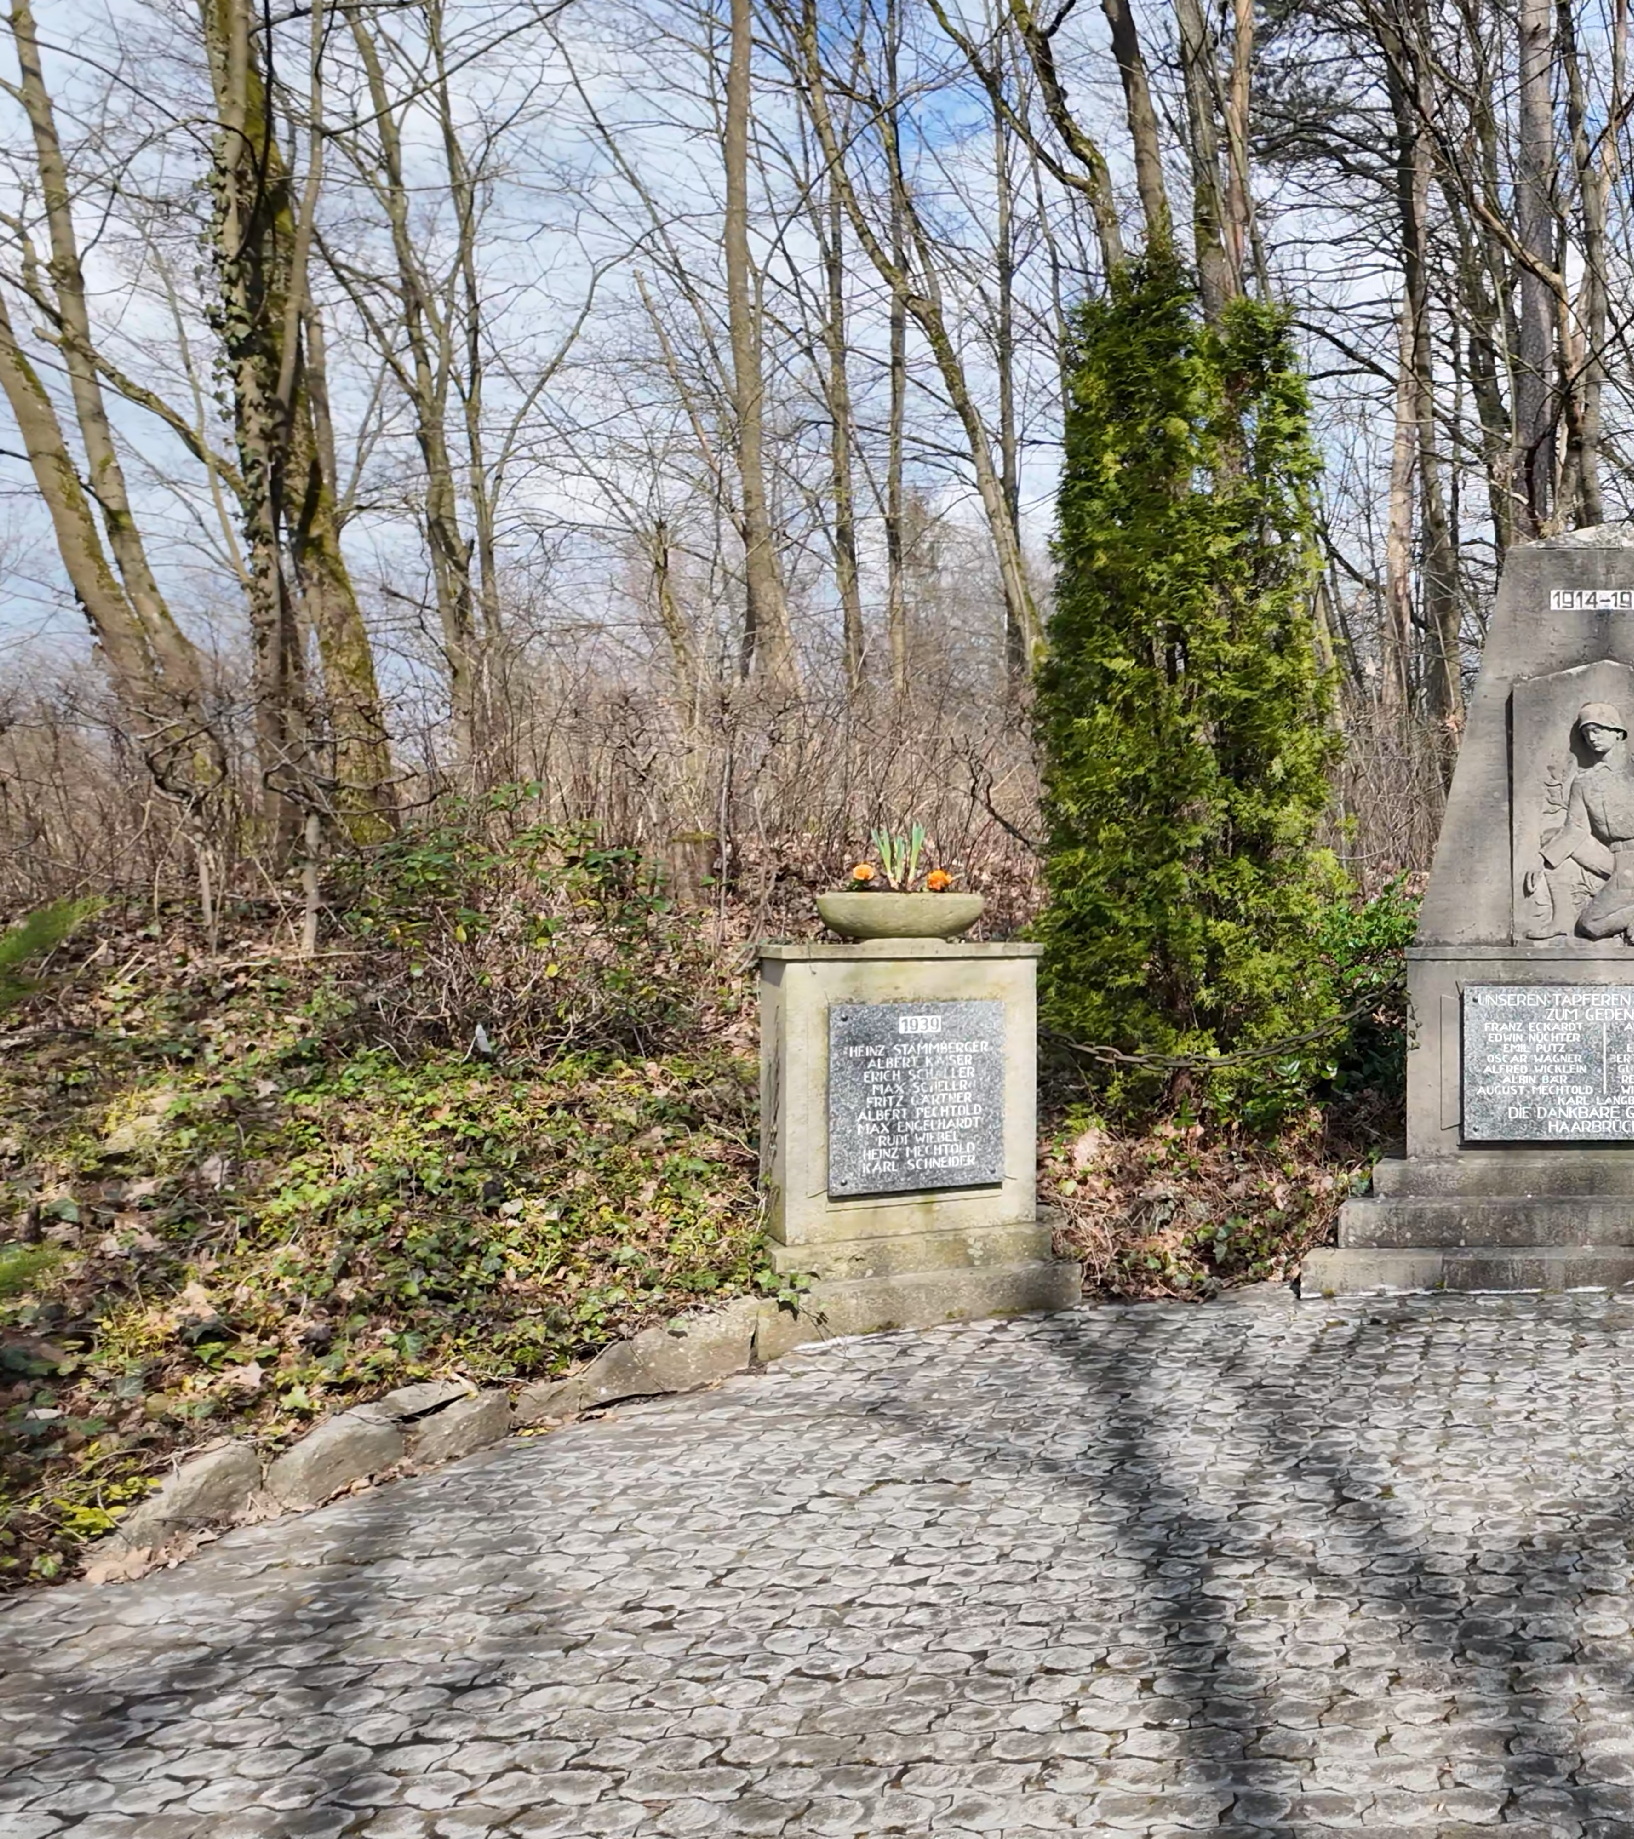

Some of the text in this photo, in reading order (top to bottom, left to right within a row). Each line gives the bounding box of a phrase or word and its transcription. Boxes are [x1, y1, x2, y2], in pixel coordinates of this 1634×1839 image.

[1477, 993, 1547, 1006] UNSEREN
[1552, 993, 1631, 1006] TAPFEREN
[1545, 1008, 1578, 1020] ZUM
[901, 1017, 941, 1033] 1939
[1484, 1022, 1583, 1032] FRANZ ECKARDT
[1488, 1033, 1523, 1043] EDWIN
[849, 1041, 989, 1057] HEINZ STAMMBERGER
[1503, 1043, 1530, 1053] EMIL
[867, 1056, 918, 1069] ALBERT
[1487, 1054, 1582, 1063] OSCAR WAGNER
[1483, 1064, 1587, 1074] ALFRED WICKLEIN
[864, 1070, 901, 1083] ERICH
[1502, 1075, 1536, 1084] ALBIN
[872, 1083, 905, 1095] MAX
[1476, 1085, 1593, 1095] AUGUST MECHTOLD
[866, 1095, 904, 1108] FRITZ
[1557, 1096, 1590, 1105] KARL
[857, 1109, 907, 1122] ALBERT
[1508, 1106, 1532, 1119] DIE
[1537, 1106, 1620, 1118] DANKBARE
[857, 1117, 981, 1135] MAX ENGELHARDT
[863, 1142, 975, 1160] HEINZ MECHTOLD
[863, 1155, 976, 1174] KARL SCHNEIDER
